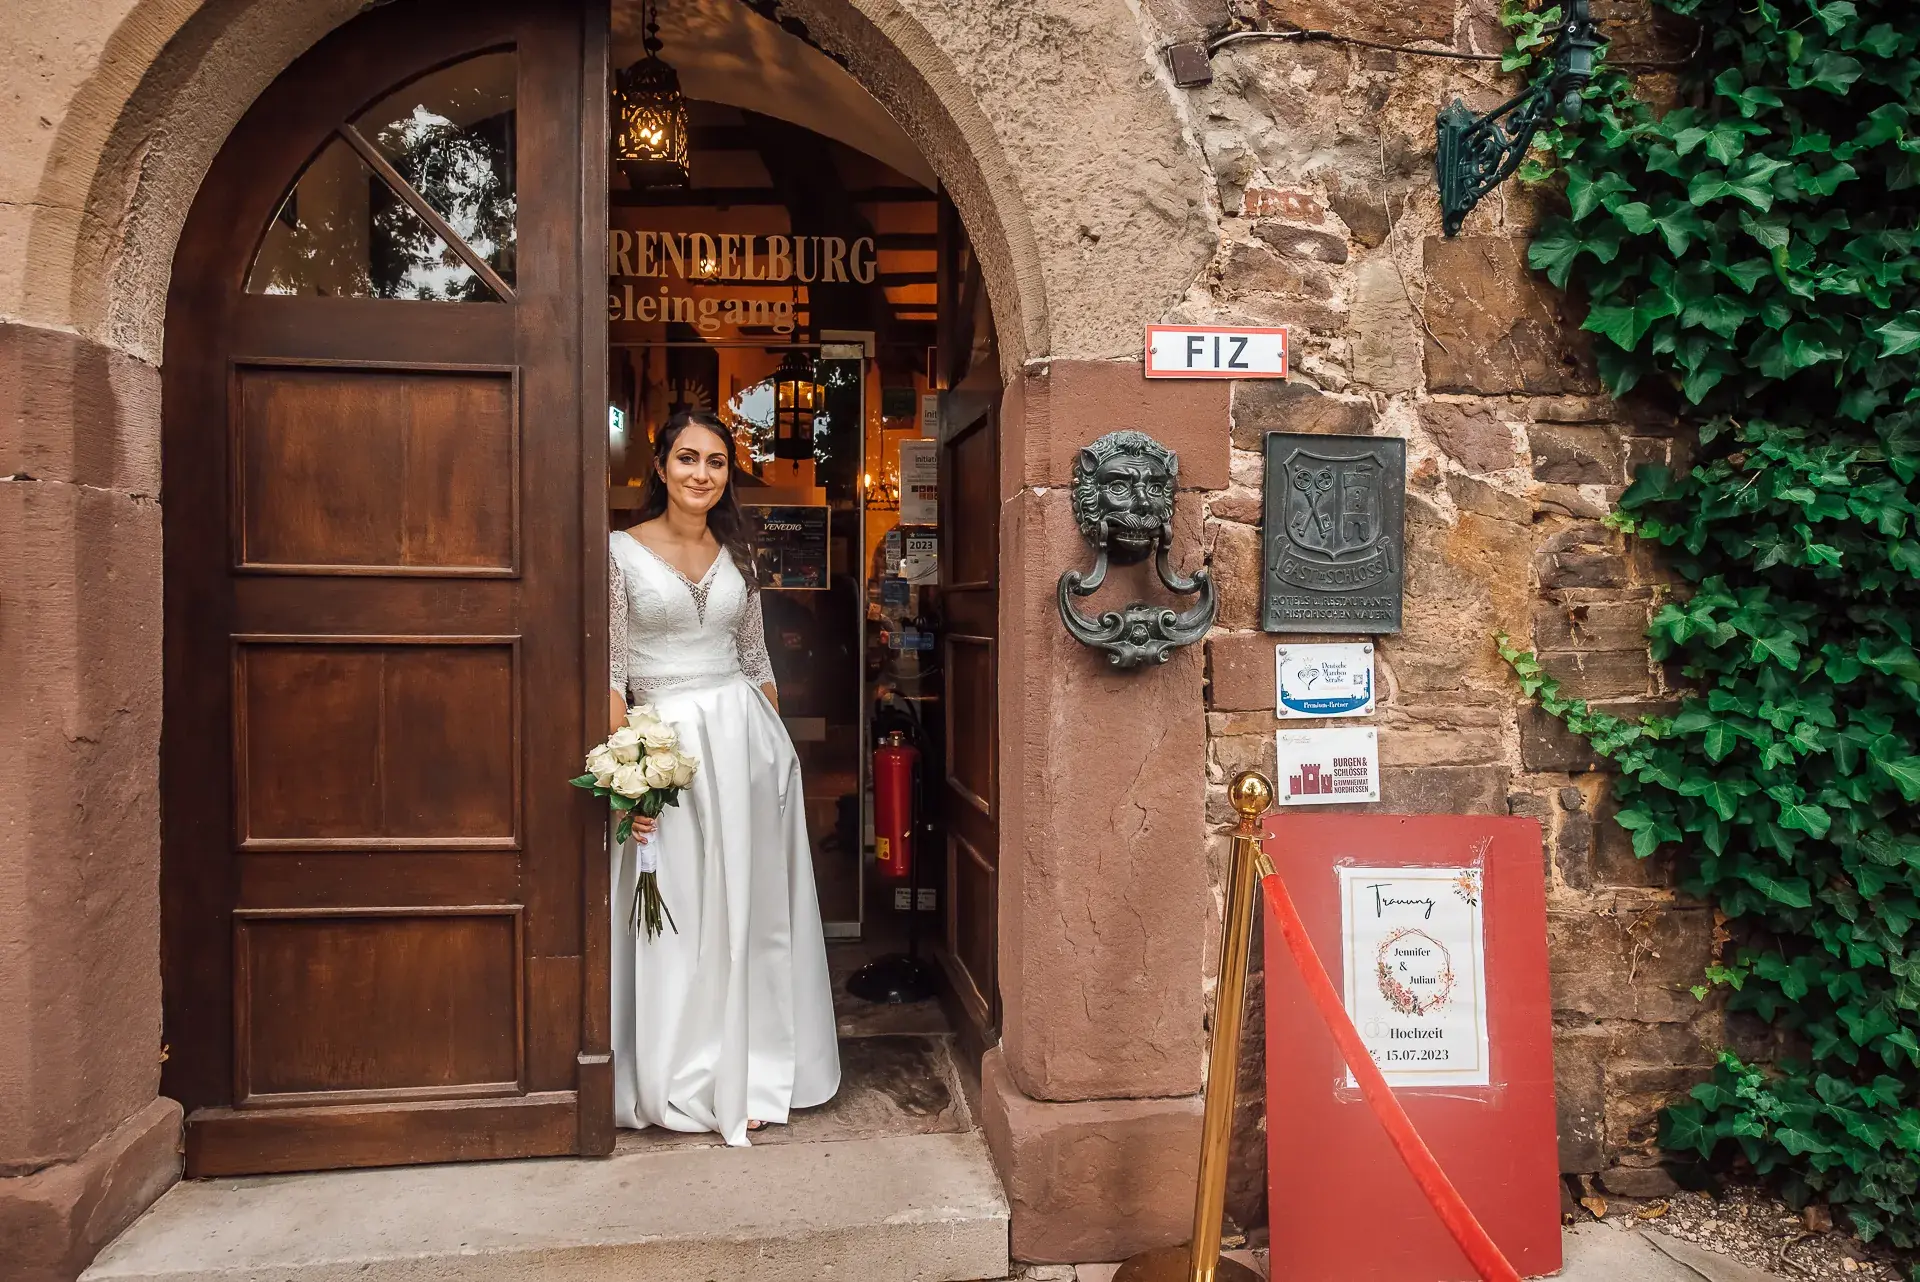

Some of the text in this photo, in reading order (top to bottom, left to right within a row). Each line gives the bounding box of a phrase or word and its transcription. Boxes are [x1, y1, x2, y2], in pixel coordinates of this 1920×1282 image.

[1186, 335, 1249, 369] FIZ
[763, 523, 803, 531] VENEDIG
[909, 541, 933, 550] 2023
[1282, 558, 1318, 583] GAST
[1326, 560, 1384, 584] SCHLOSS
[1271, 595, 1311, 606] HOTELS
[1322, 596, 1393, 607] RESTAURANTS
[1270, 608, 1393, 620] IN HISTORISCHEN MAUERN
[1333, 757, 1368, 767] BURGEN &
[1333, 767, 1368, 777] SCHLÖSSER
[1333, 785, 1369, 794] NORDHESSEN
[1366, 883, 1436, 920] Trauung
[1393, 947, 1431, 958] Jennifer
[1399, 961, 1408, 972] &
[1409, 975, 1436, 986] Julian
[1390, 1027, 1444, 1039] Hochzeit
[1386, 1049, 1450, 1061] 15.07.2023
